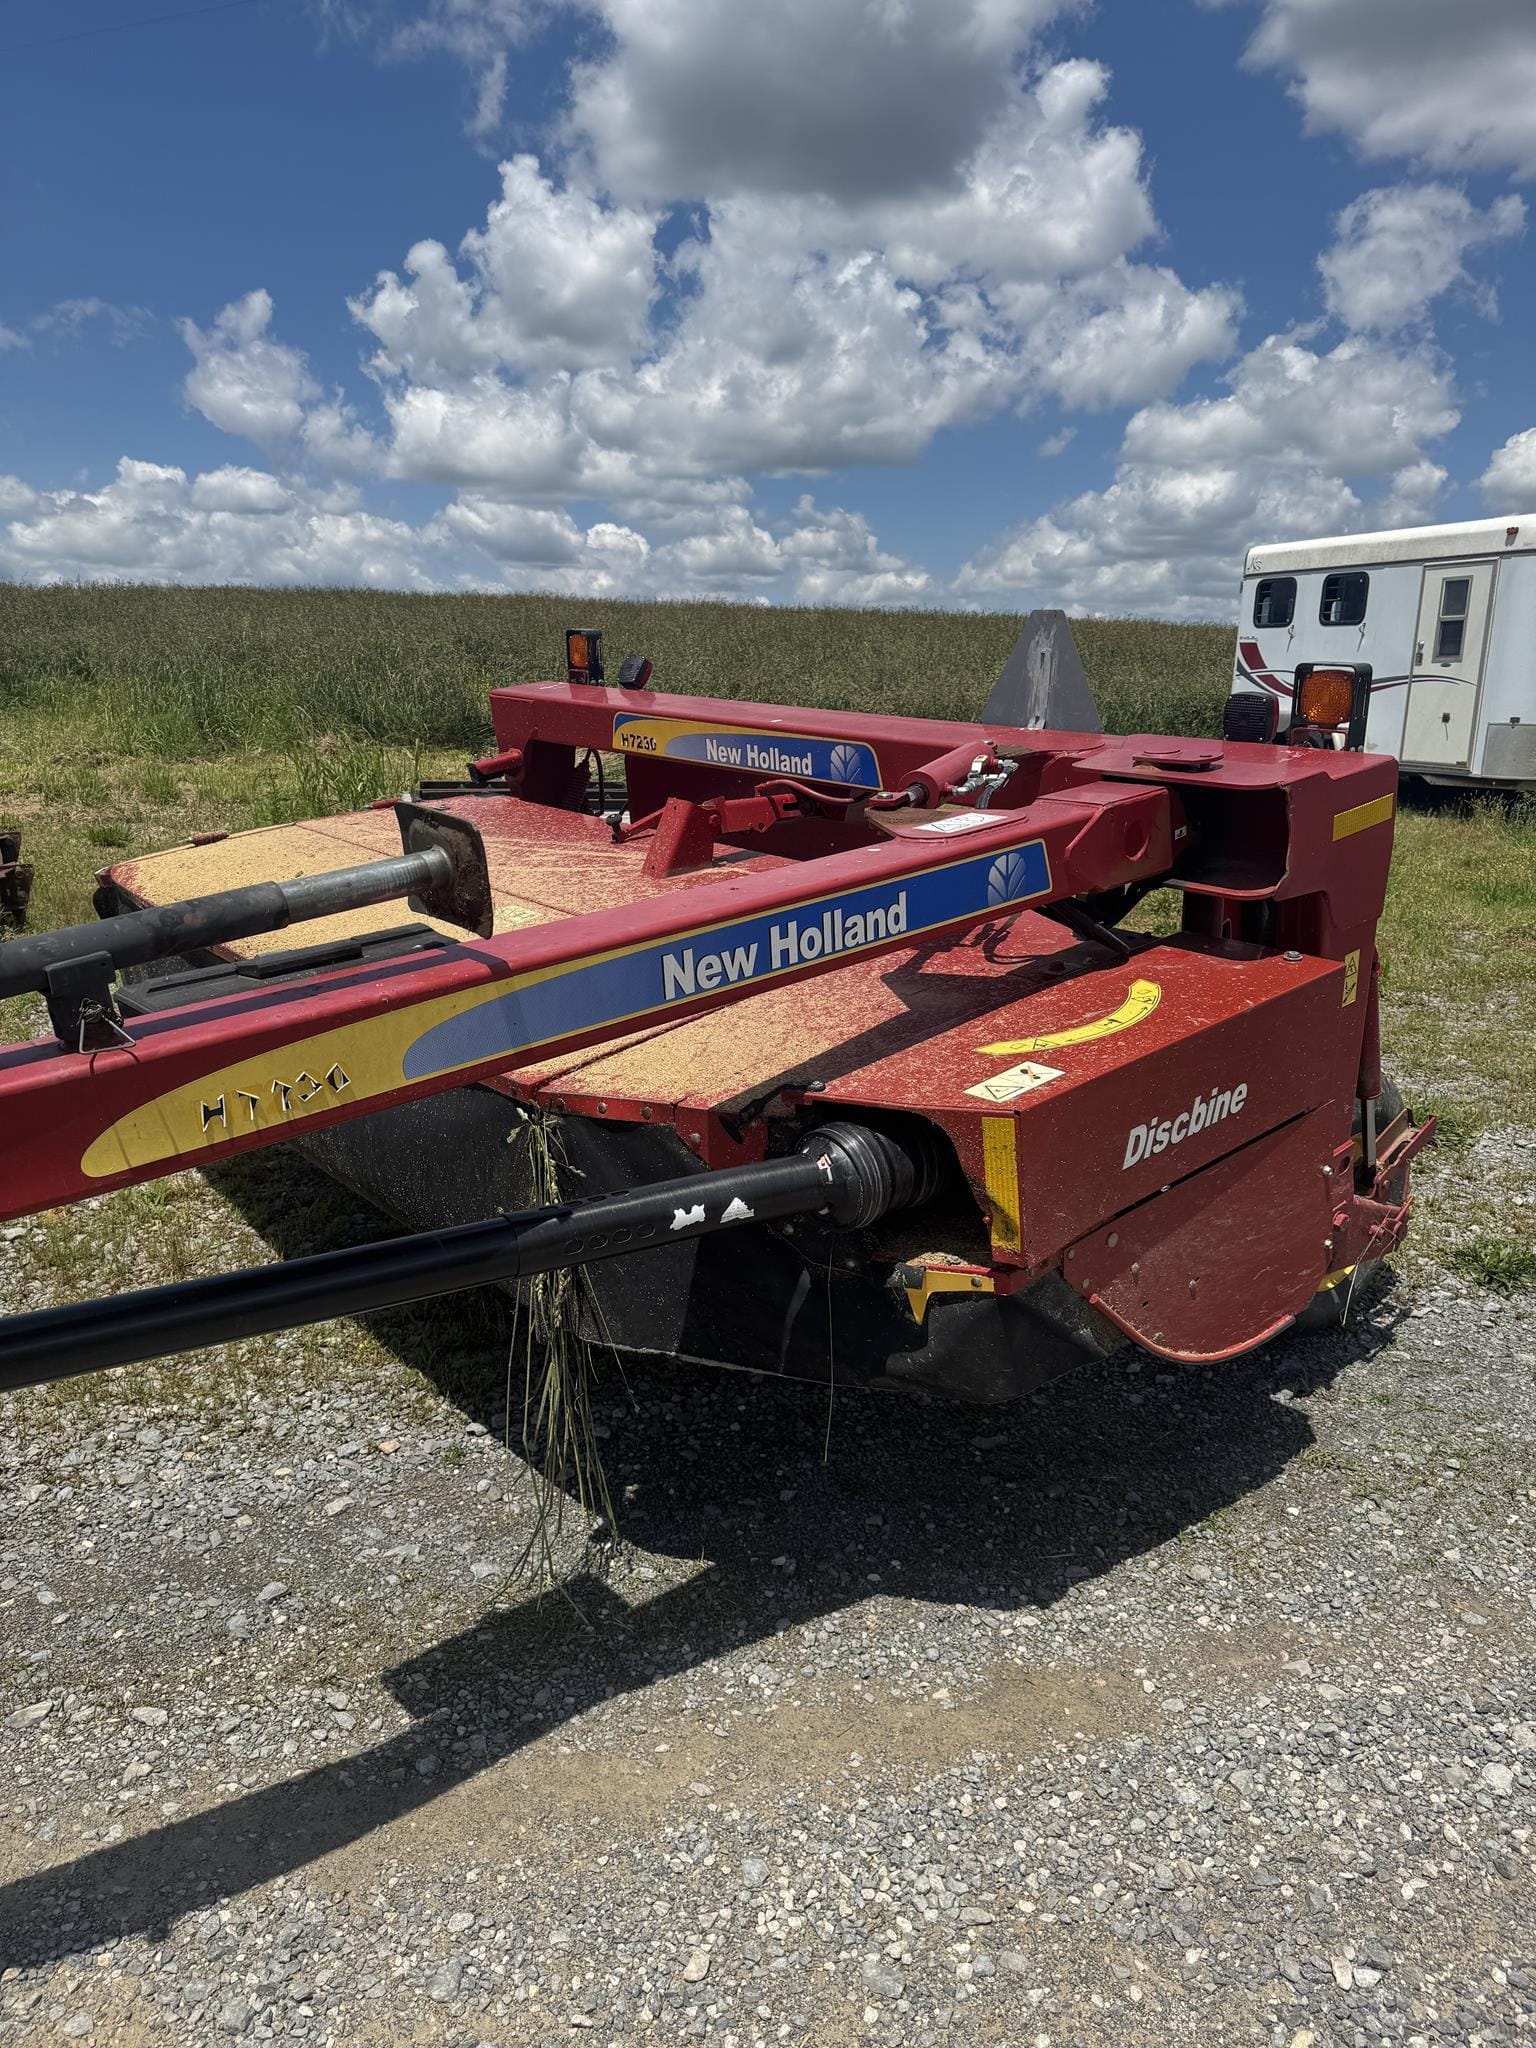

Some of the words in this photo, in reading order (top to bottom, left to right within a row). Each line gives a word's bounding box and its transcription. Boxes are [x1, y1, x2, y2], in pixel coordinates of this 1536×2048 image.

[620, 732, 657, 751] H7230
[705, 738, 742, 765] New
[747, 744, 812, 776] Holland
[662, 942, 758, 1000] New
[769, 891, 907, 969] Holland
[1122, 1082, 1248, 1170] Discbine
